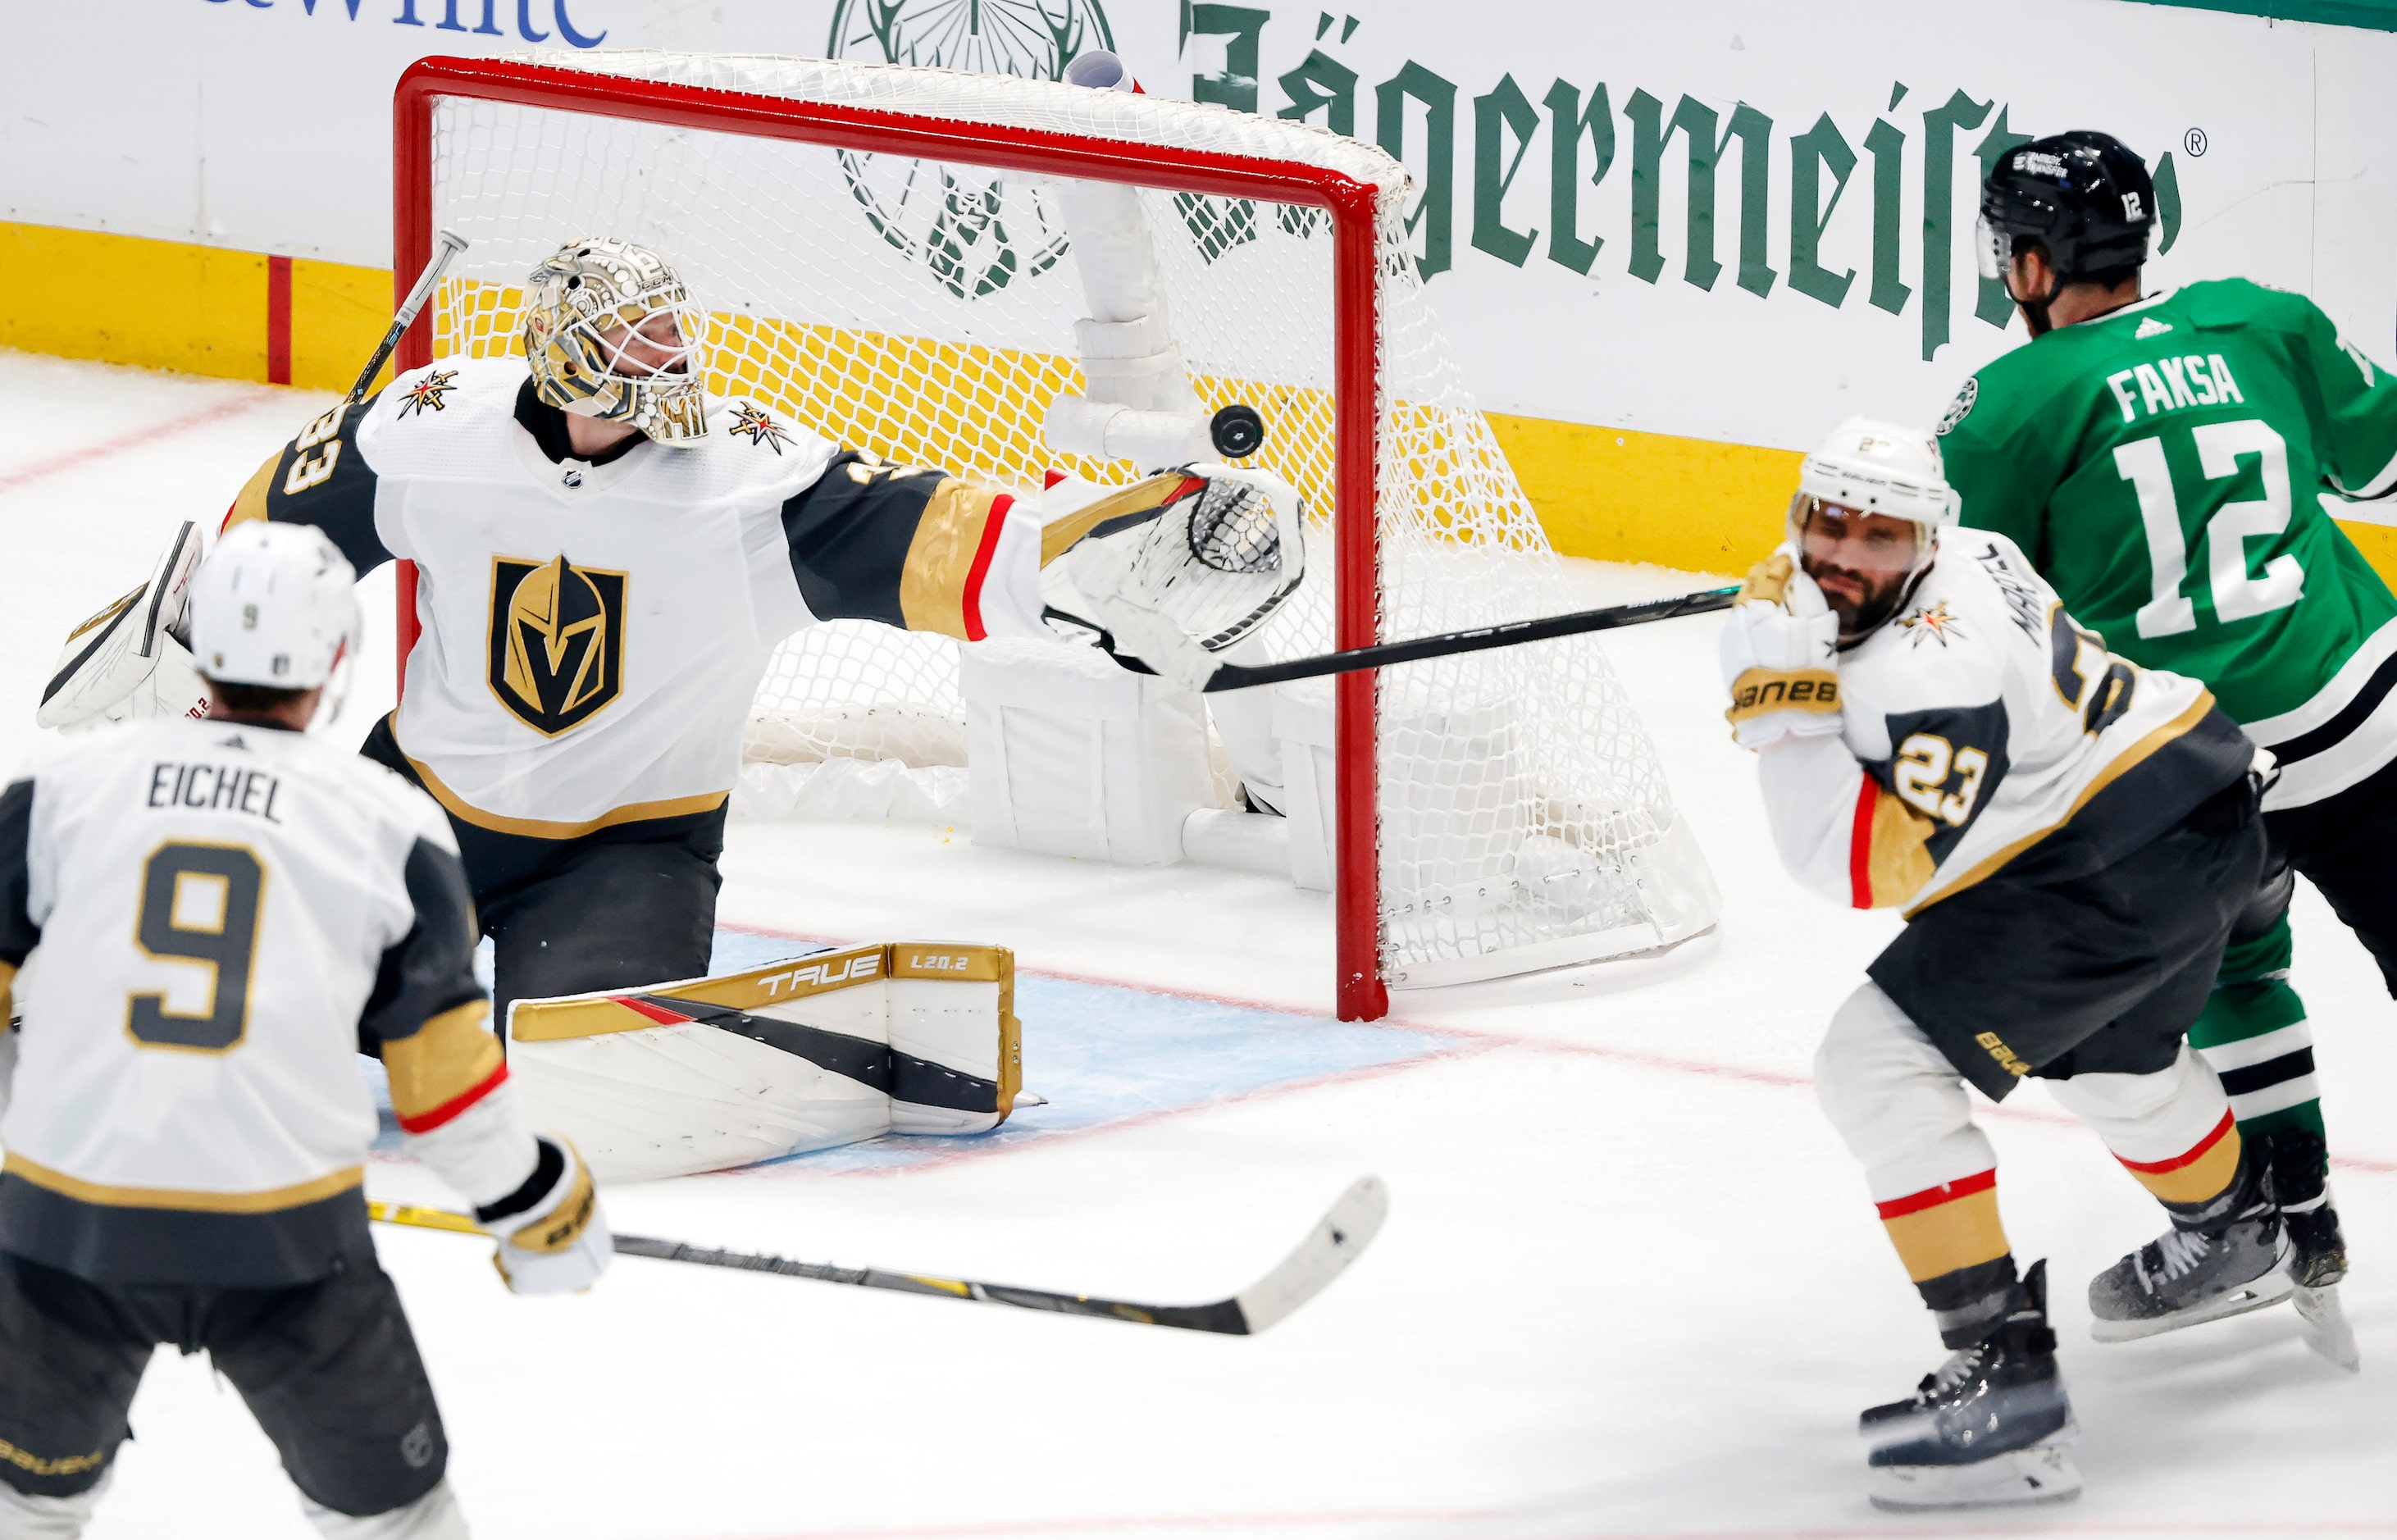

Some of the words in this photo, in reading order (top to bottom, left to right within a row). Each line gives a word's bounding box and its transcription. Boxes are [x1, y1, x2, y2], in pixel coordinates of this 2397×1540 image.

[2121, 191, 2144, 222] 12
[2107, 355, 2245, 423] FAKSA
[2113, 418, 2305, 640] 12
[146, 763, 284, 824] EICHEL
[1893, 731, 1989, 827] 23
[124, 838, 270, 1054] 9
[756, 953, 882, 997] TRUE
[910, 955, 969, 972] L20.2
